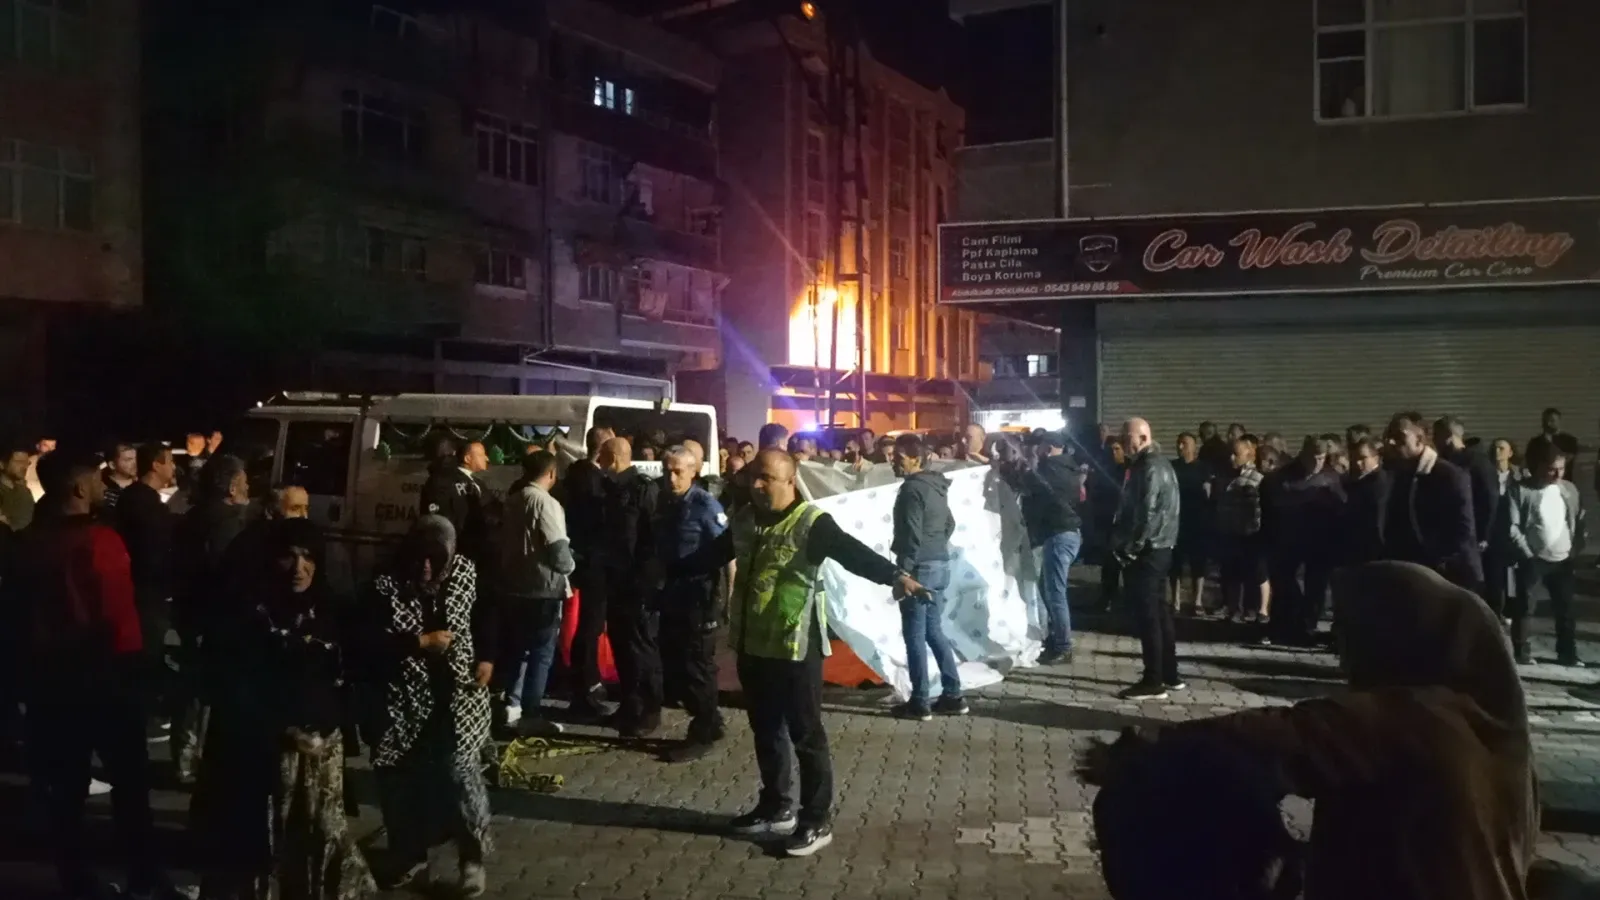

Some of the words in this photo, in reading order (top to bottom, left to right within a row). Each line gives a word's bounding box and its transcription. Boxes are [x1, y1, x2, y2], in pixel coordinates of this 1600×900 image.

[962, 236, 989, 246] Cam
[992, 235, 1022, 245] Filmi
[1142, 228, 1226, 272] Car
[1228, 221, 1353, 270] Wash
[1360, 218, 1575, 268] Detailing
[962, 248, 984, 260] Ppf
[986, 246, 1039, 258] Kaplama
[962, 260, 996, 270] Pasta
[999, 258, 1023, 268] Cila
[962, 272, 992, 283] Boya
[994, 270, 1042, 281] Koruma
[1360, 264, 1439, 281] Premium
[1444, 262, 1482, 279] Car
[1486, 261, 1533, 278] Care
